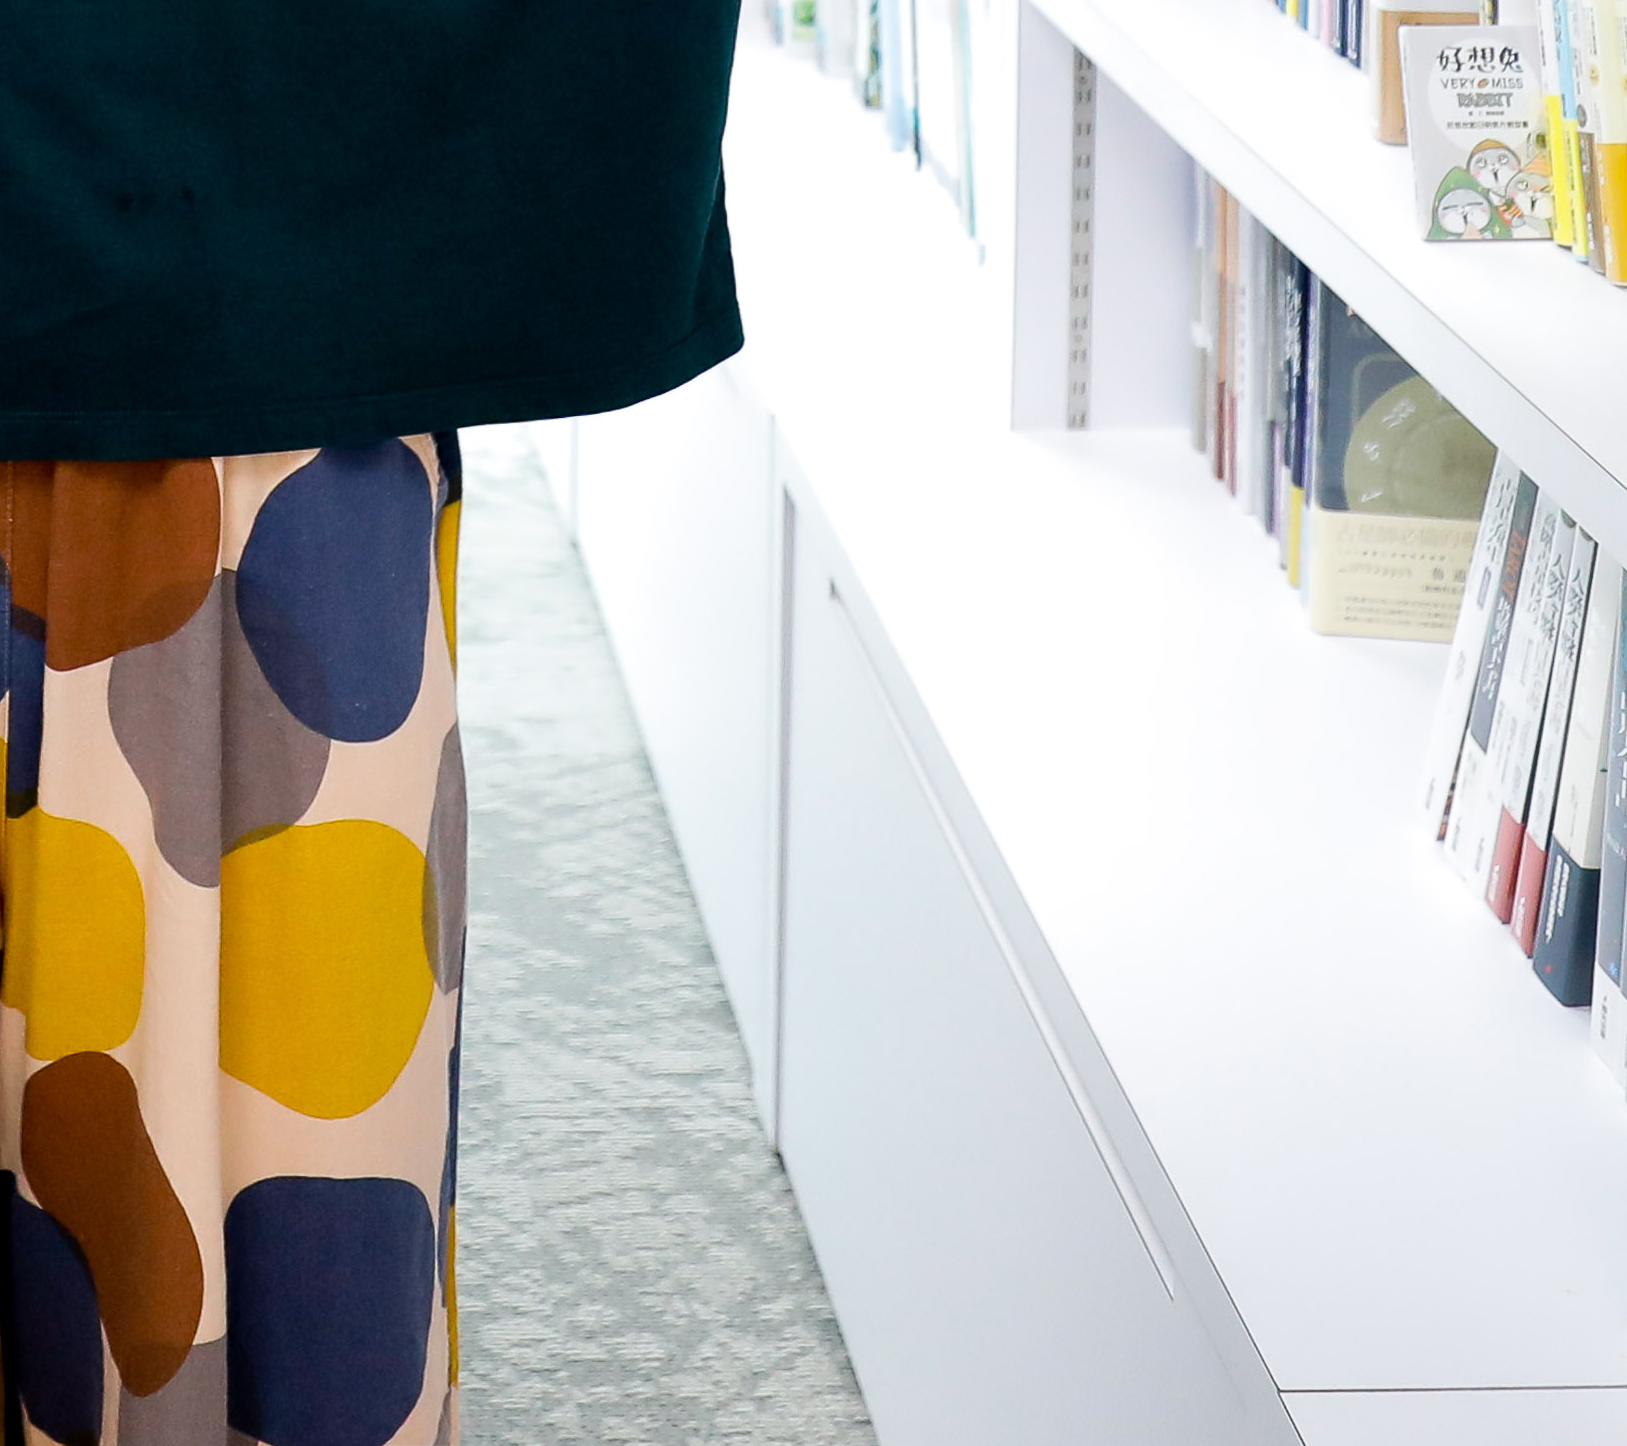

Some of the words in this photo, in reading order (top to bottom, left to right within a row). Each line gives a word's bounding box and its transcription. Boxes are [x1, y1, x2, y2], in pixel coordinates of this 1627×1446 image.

[1437, 46, 1525, 74] 好想兔
[1441, 77, 1477, 91] VERY
[1491, 77, 1525, 91] MISS
